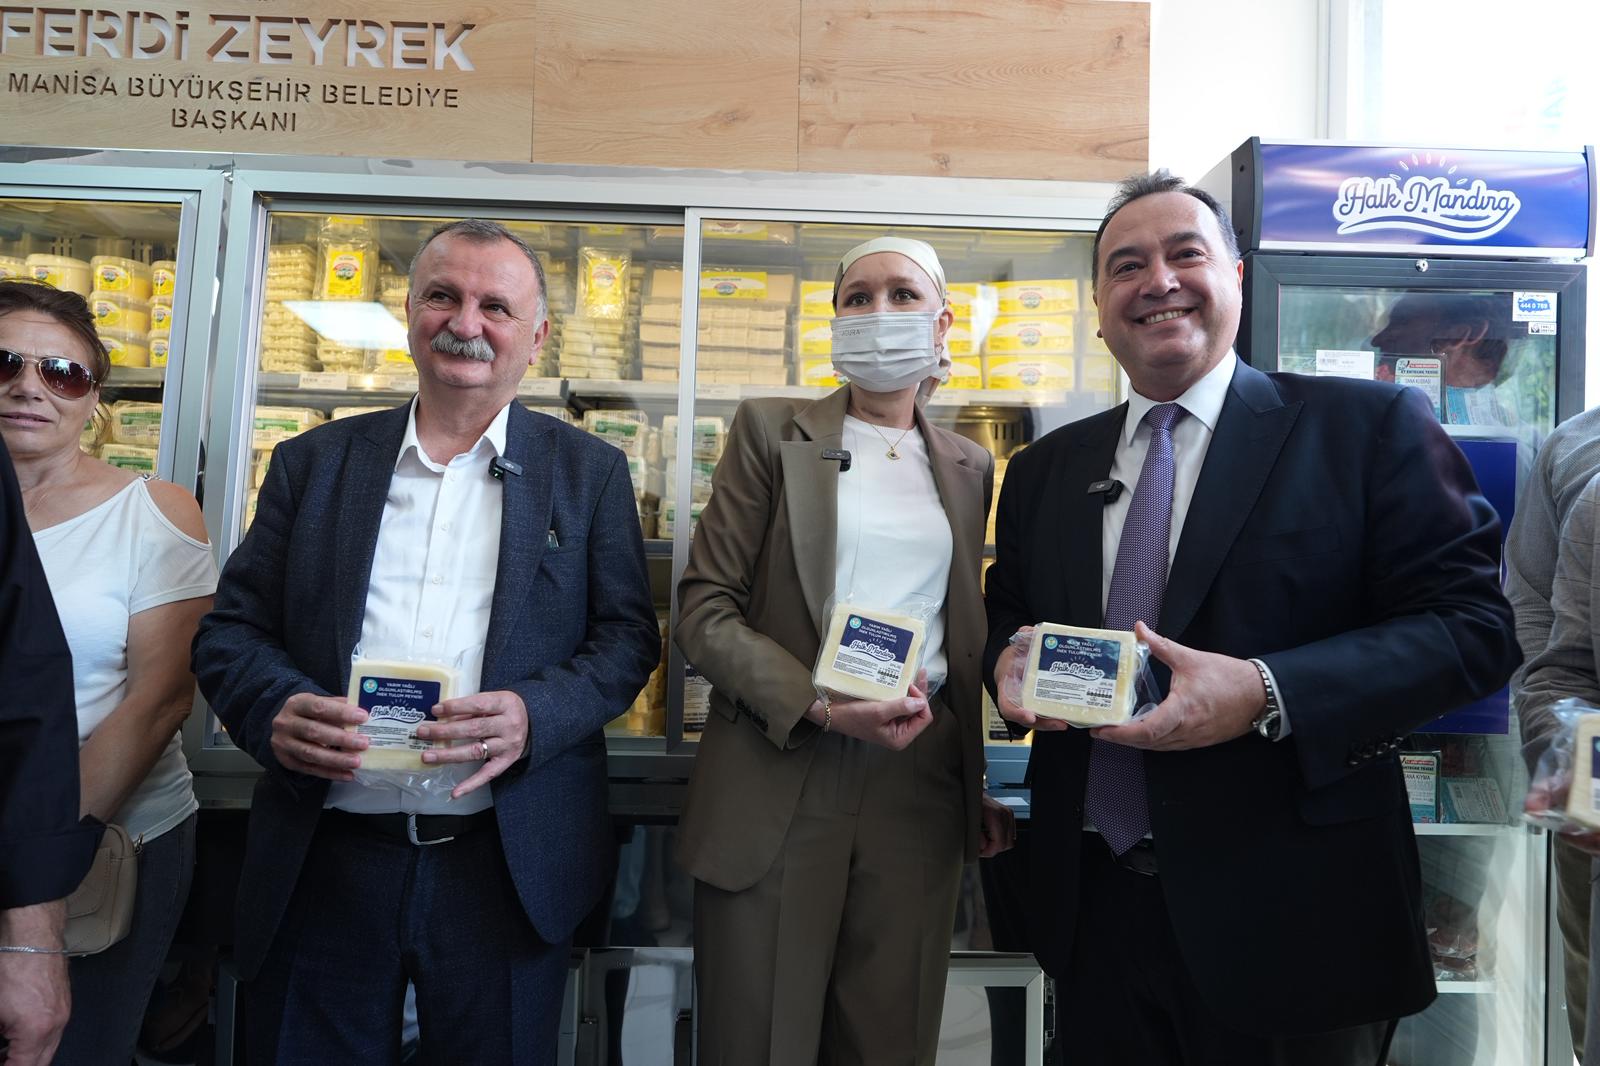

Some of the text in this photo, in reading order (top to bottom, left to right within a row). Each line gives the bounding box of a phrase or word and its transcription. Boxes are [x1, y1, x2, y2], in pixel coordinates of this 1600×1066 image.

[206, 14, 476, 71] ZEYREK
[8, 70, 459, 109] MANİSA BÜYÜKŞEHİR BELEDİYE
[171, 107, 298, 135] BAŞKANI
[1339, 180, 1402, 216] Halk
